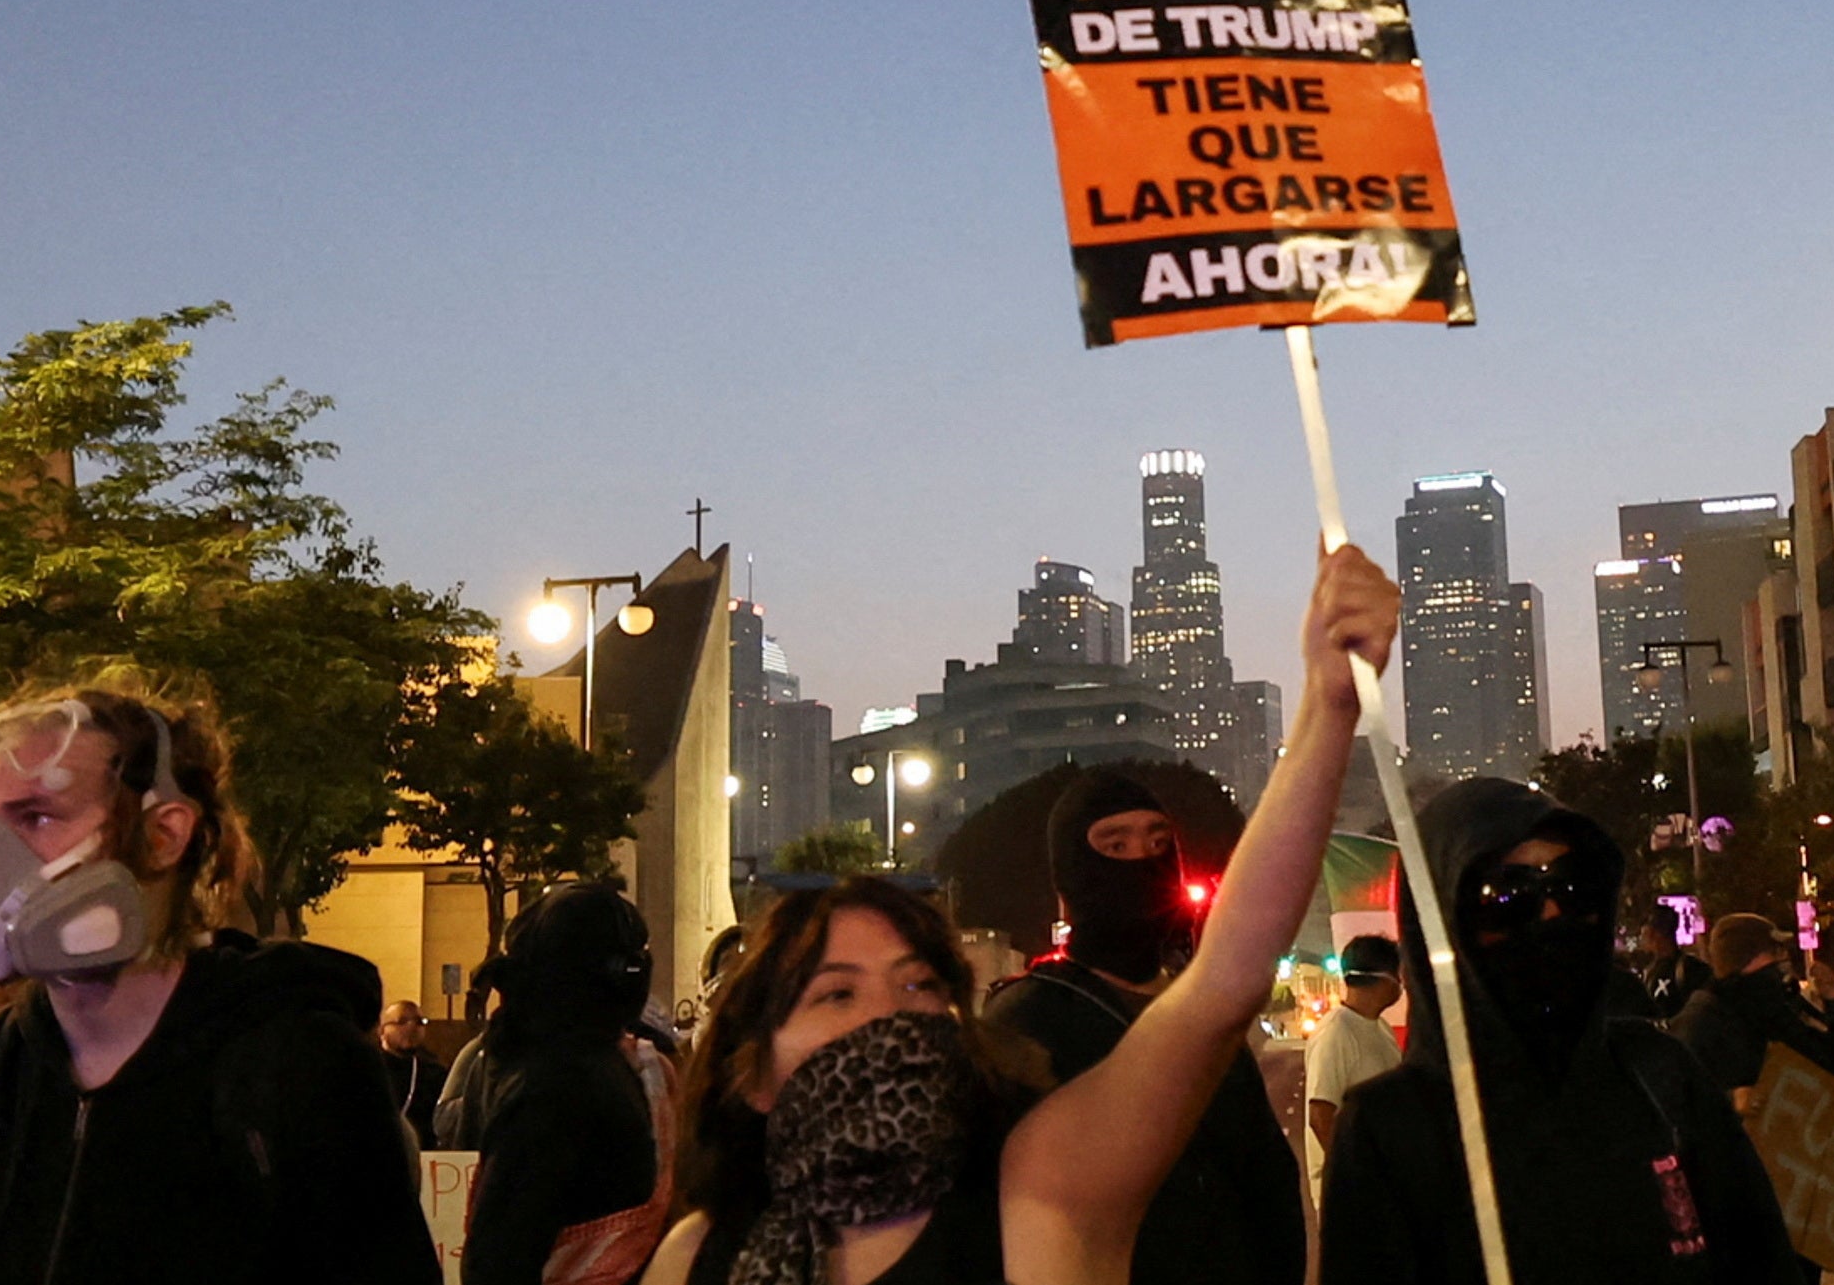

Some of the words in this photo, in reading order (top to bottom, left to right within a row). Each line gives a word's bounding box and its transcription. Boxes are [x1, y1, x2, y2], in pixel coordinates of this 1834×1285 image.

[1069, 9, 1159, 54] DE
[1164, 5, 1375, 52] TRUMP
[1137, 74, 1330, 115] TIENE
[1188, 124, 1324, 168] QUE
[1086, 174, 1434, 227] LARGARSE
